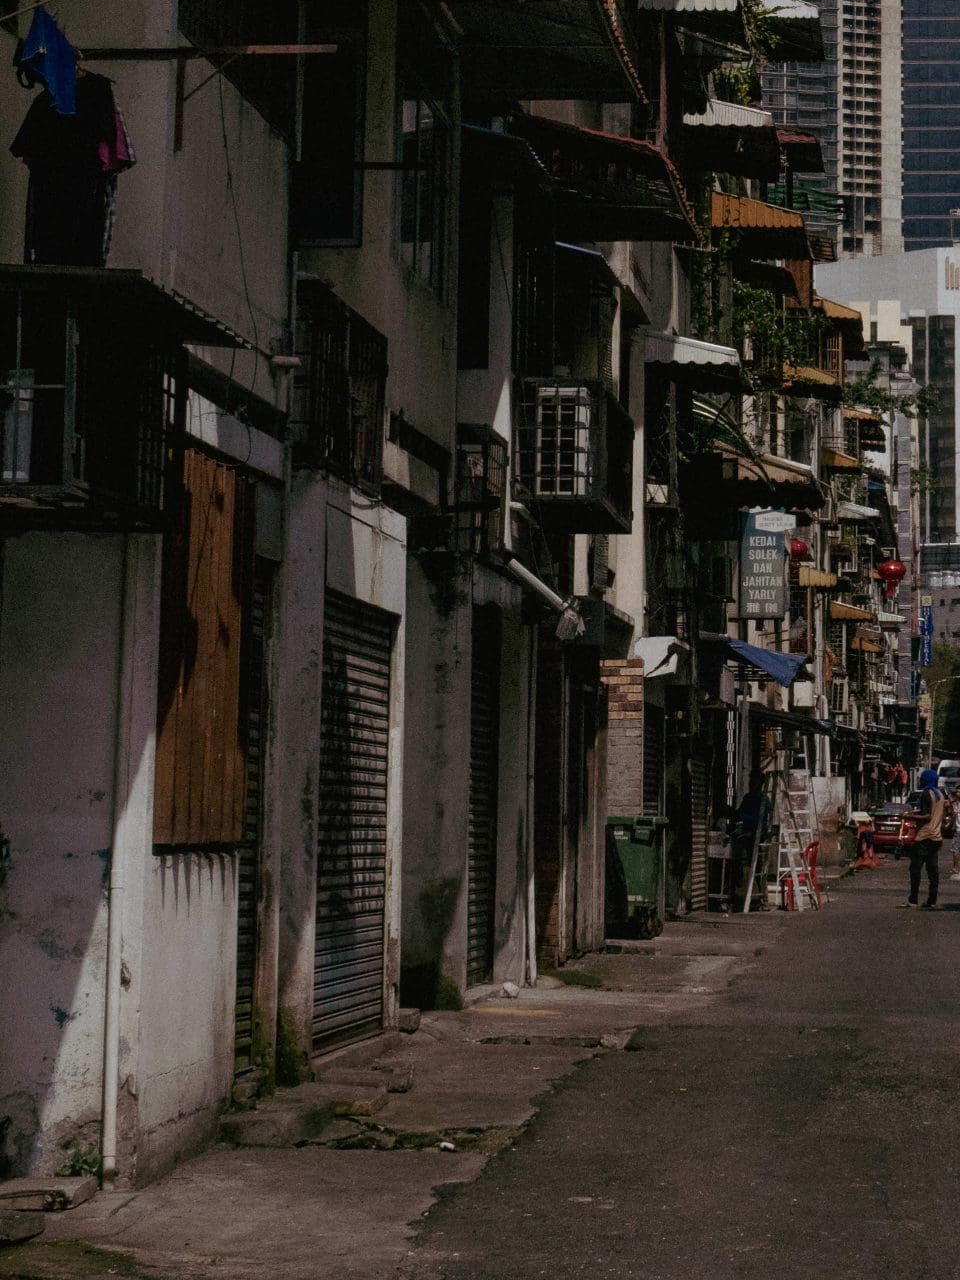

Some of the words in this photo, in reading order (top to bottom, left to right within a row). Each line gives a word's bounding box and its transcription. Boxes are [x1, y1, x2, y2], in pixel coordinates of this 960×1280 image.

[749, 536, 776, 547] KEDAI
[748, 549, 778, 560] SOLEK
[753, 563, 773, 573] DAN
[743, 576, 783, 587] JAHITAN
[748, 589, 777, 600] YARLY
